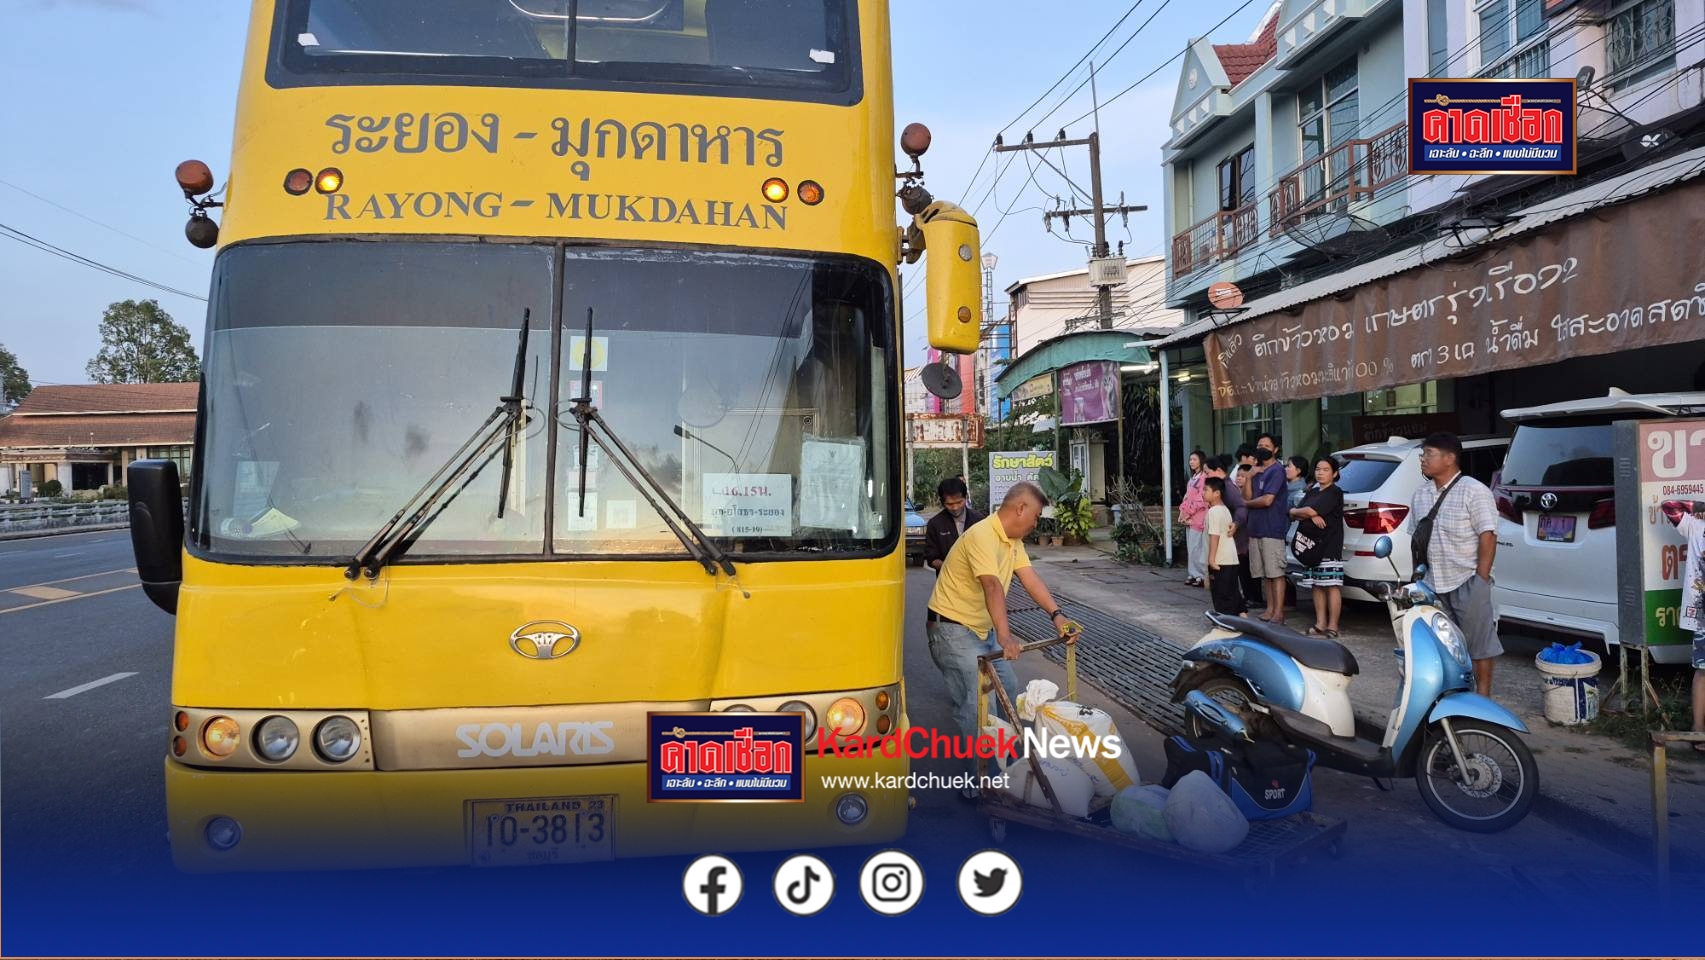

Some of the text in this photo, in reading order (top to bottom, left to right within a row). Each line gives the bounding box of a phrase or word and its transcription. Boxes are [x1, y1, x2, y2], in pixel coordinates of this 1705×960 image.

[325, 112, 499, 154] ระยอง
[551, 116, 785, 181] มุกดาหาร
[323, 191, 503, 221] RAYONG
[546, 191, 788, 231] MUKDAHAN
[993, 453, 1053, 469] รักษาสัตว์
[456, 721, 615, 758] SOLARIS
[506, 801, 581, 812] THAILAND
[1264, 788, 1286, 800] SPORT
